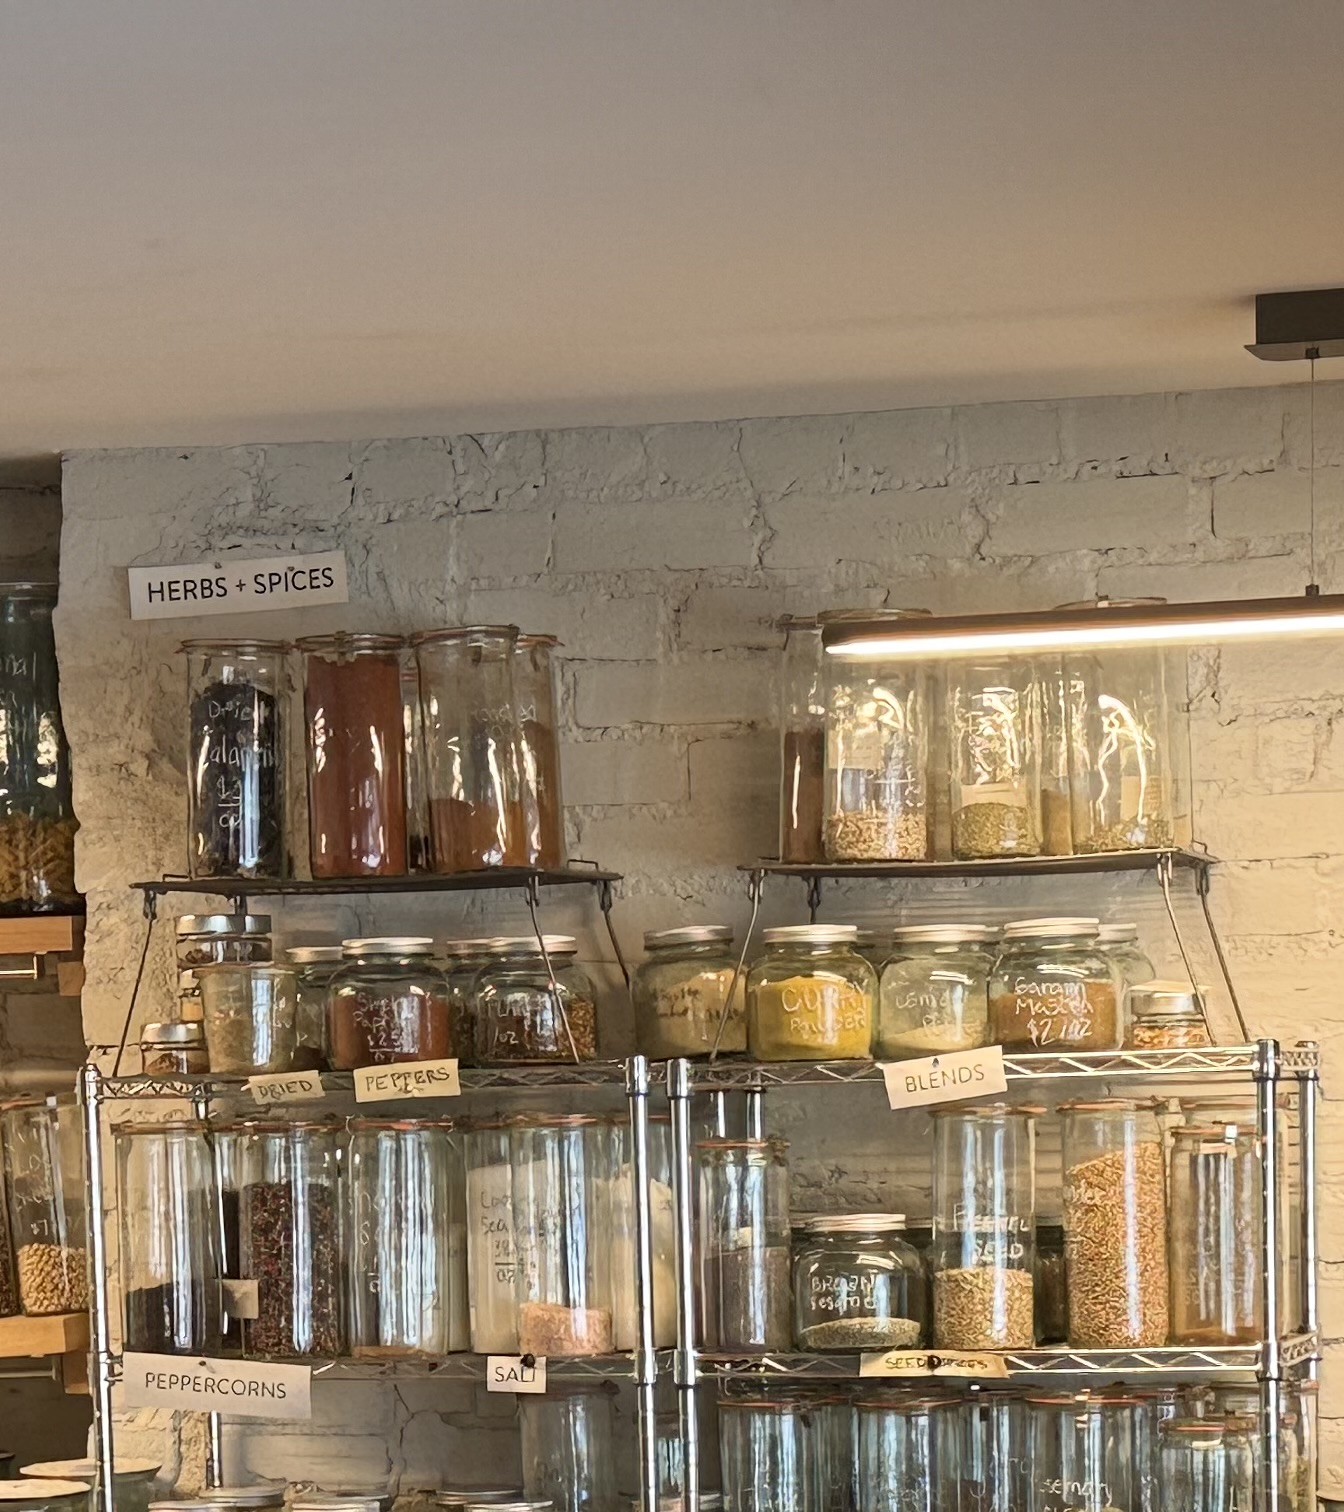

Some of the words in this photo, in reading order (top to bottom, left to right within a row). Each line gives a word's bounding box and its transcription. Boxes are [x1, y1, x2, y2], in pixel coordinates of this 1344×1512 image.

[147, 578, 228, 604] HERBS
[236, 579, 247, 593] +
[253, 566, 335, 595] SPICES
[257, 1077, 313, 1101] DRIED
[905, 1063, 986, 1093] BLENDS
[145, 1372, 287, 1399] PEPPERCORNS
